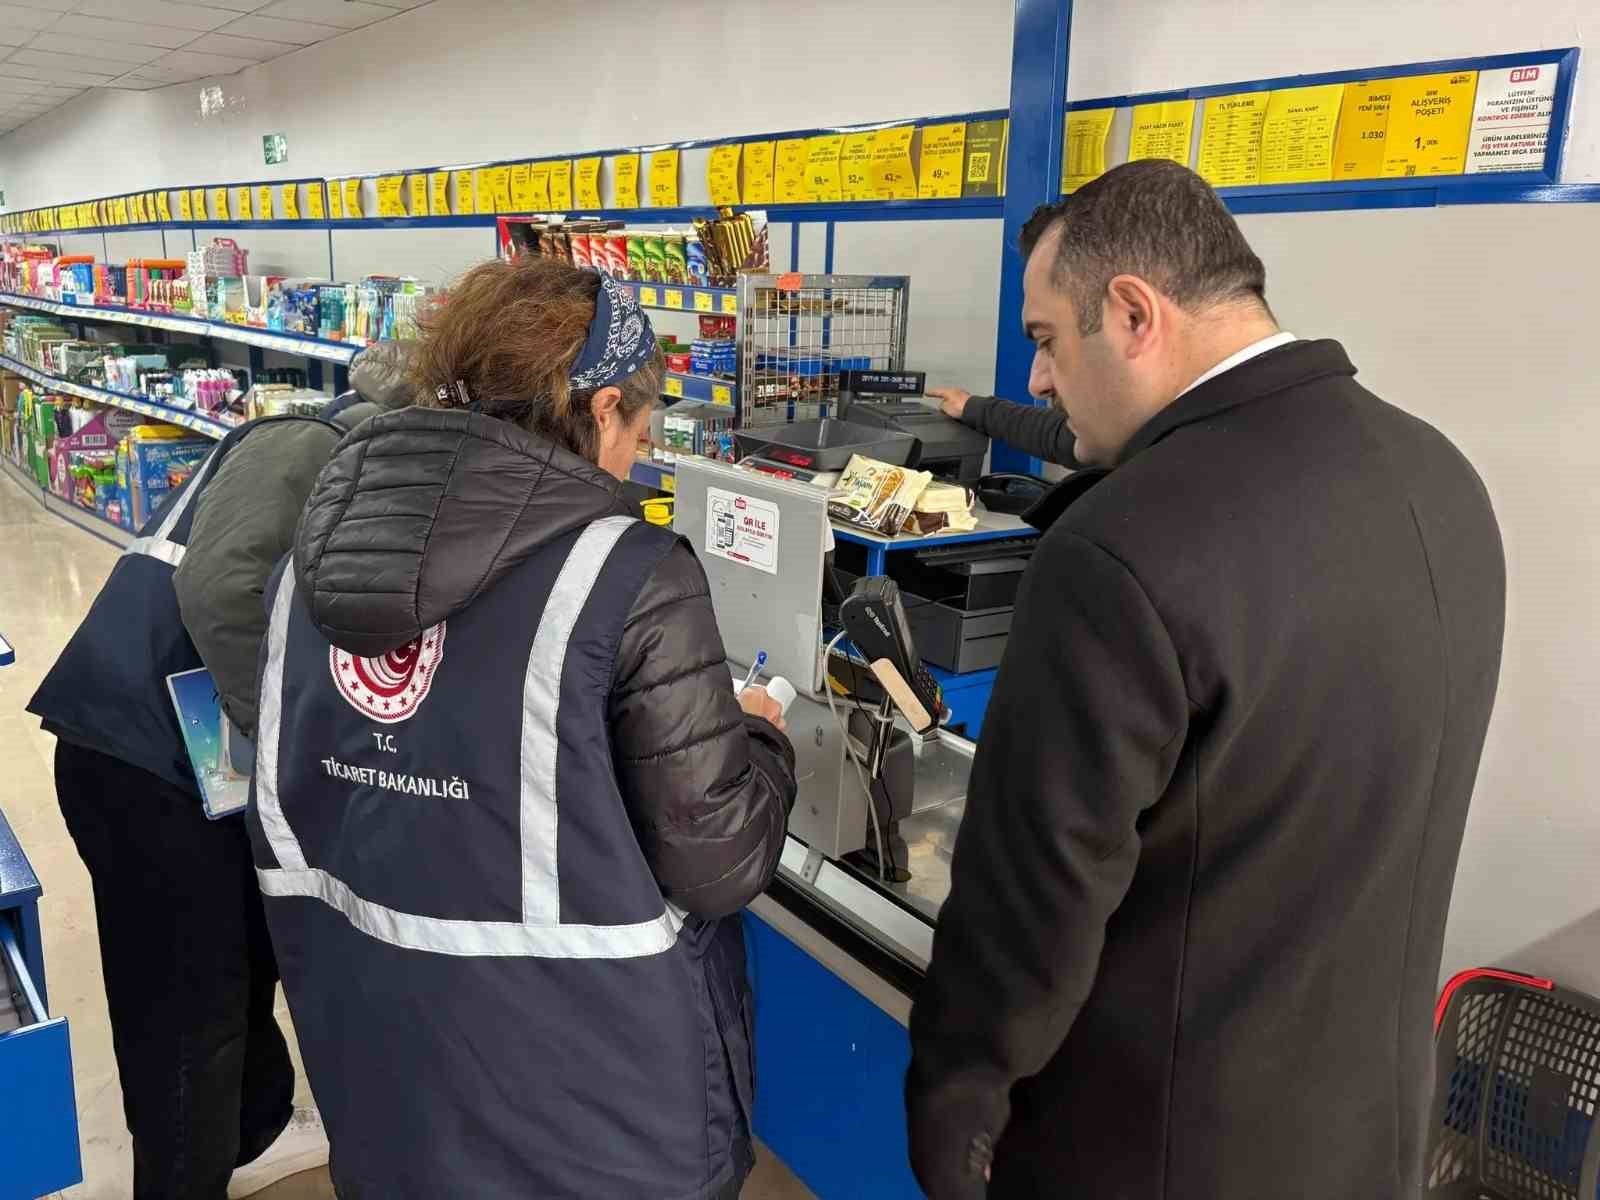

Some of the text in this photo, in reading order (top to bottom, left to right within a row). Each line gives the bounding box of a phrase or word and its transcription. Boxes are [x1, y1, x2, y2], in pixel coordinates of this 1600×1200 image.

[744, 516, 754, 527] QR
[372, 732, 397, 753] T.C.
[321, 756, 470, 800] TİCARET BAKANLIĞI
